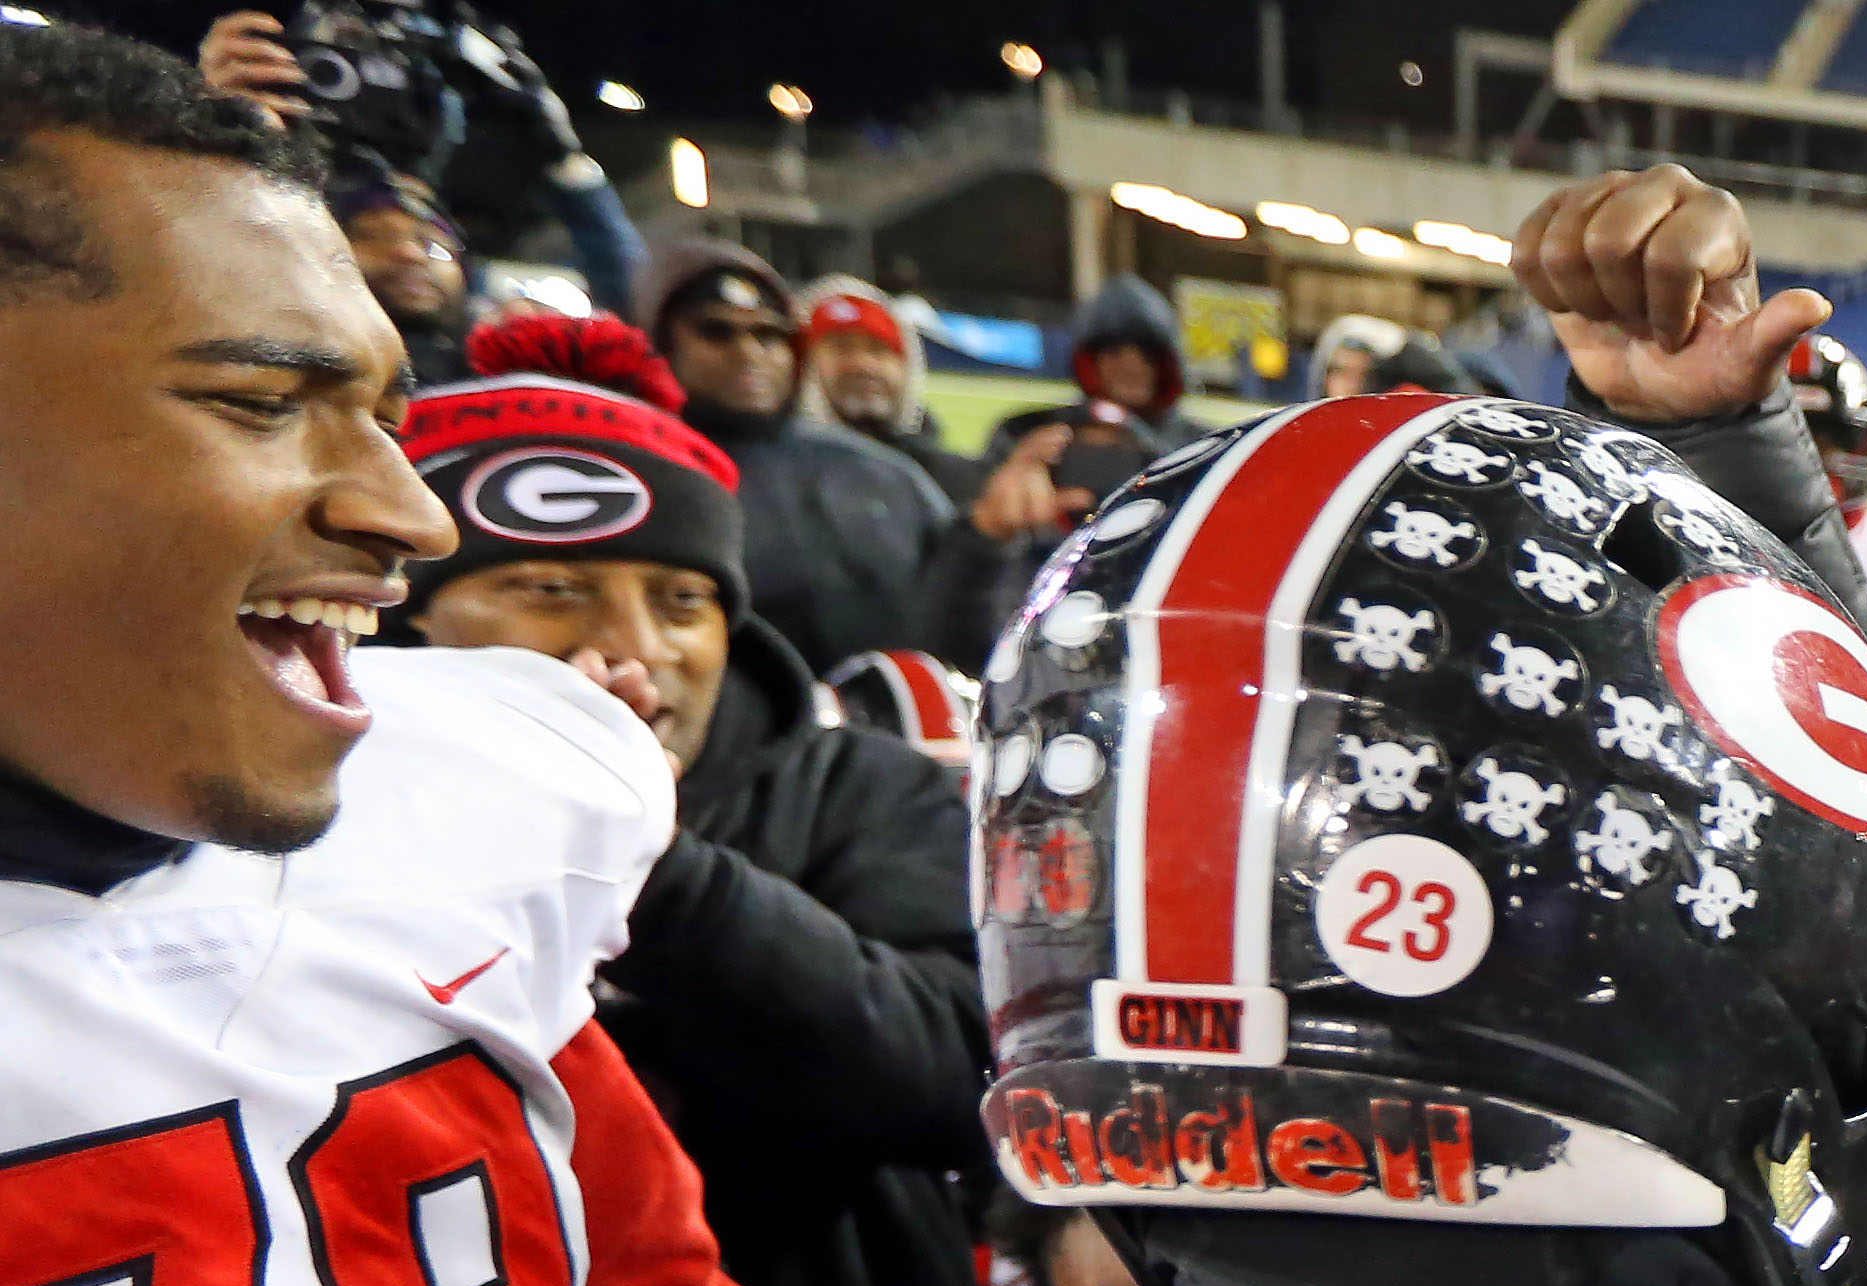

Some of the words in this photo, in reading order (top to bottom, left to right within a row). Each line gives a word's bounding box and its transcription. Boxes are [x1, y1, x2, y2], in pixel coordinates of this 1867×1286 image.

[1345, 869, 1457, 963] 23
[1120, 993, 1244, 1054] GINN
[1005, 1082, 1479, 1206] Riddell
